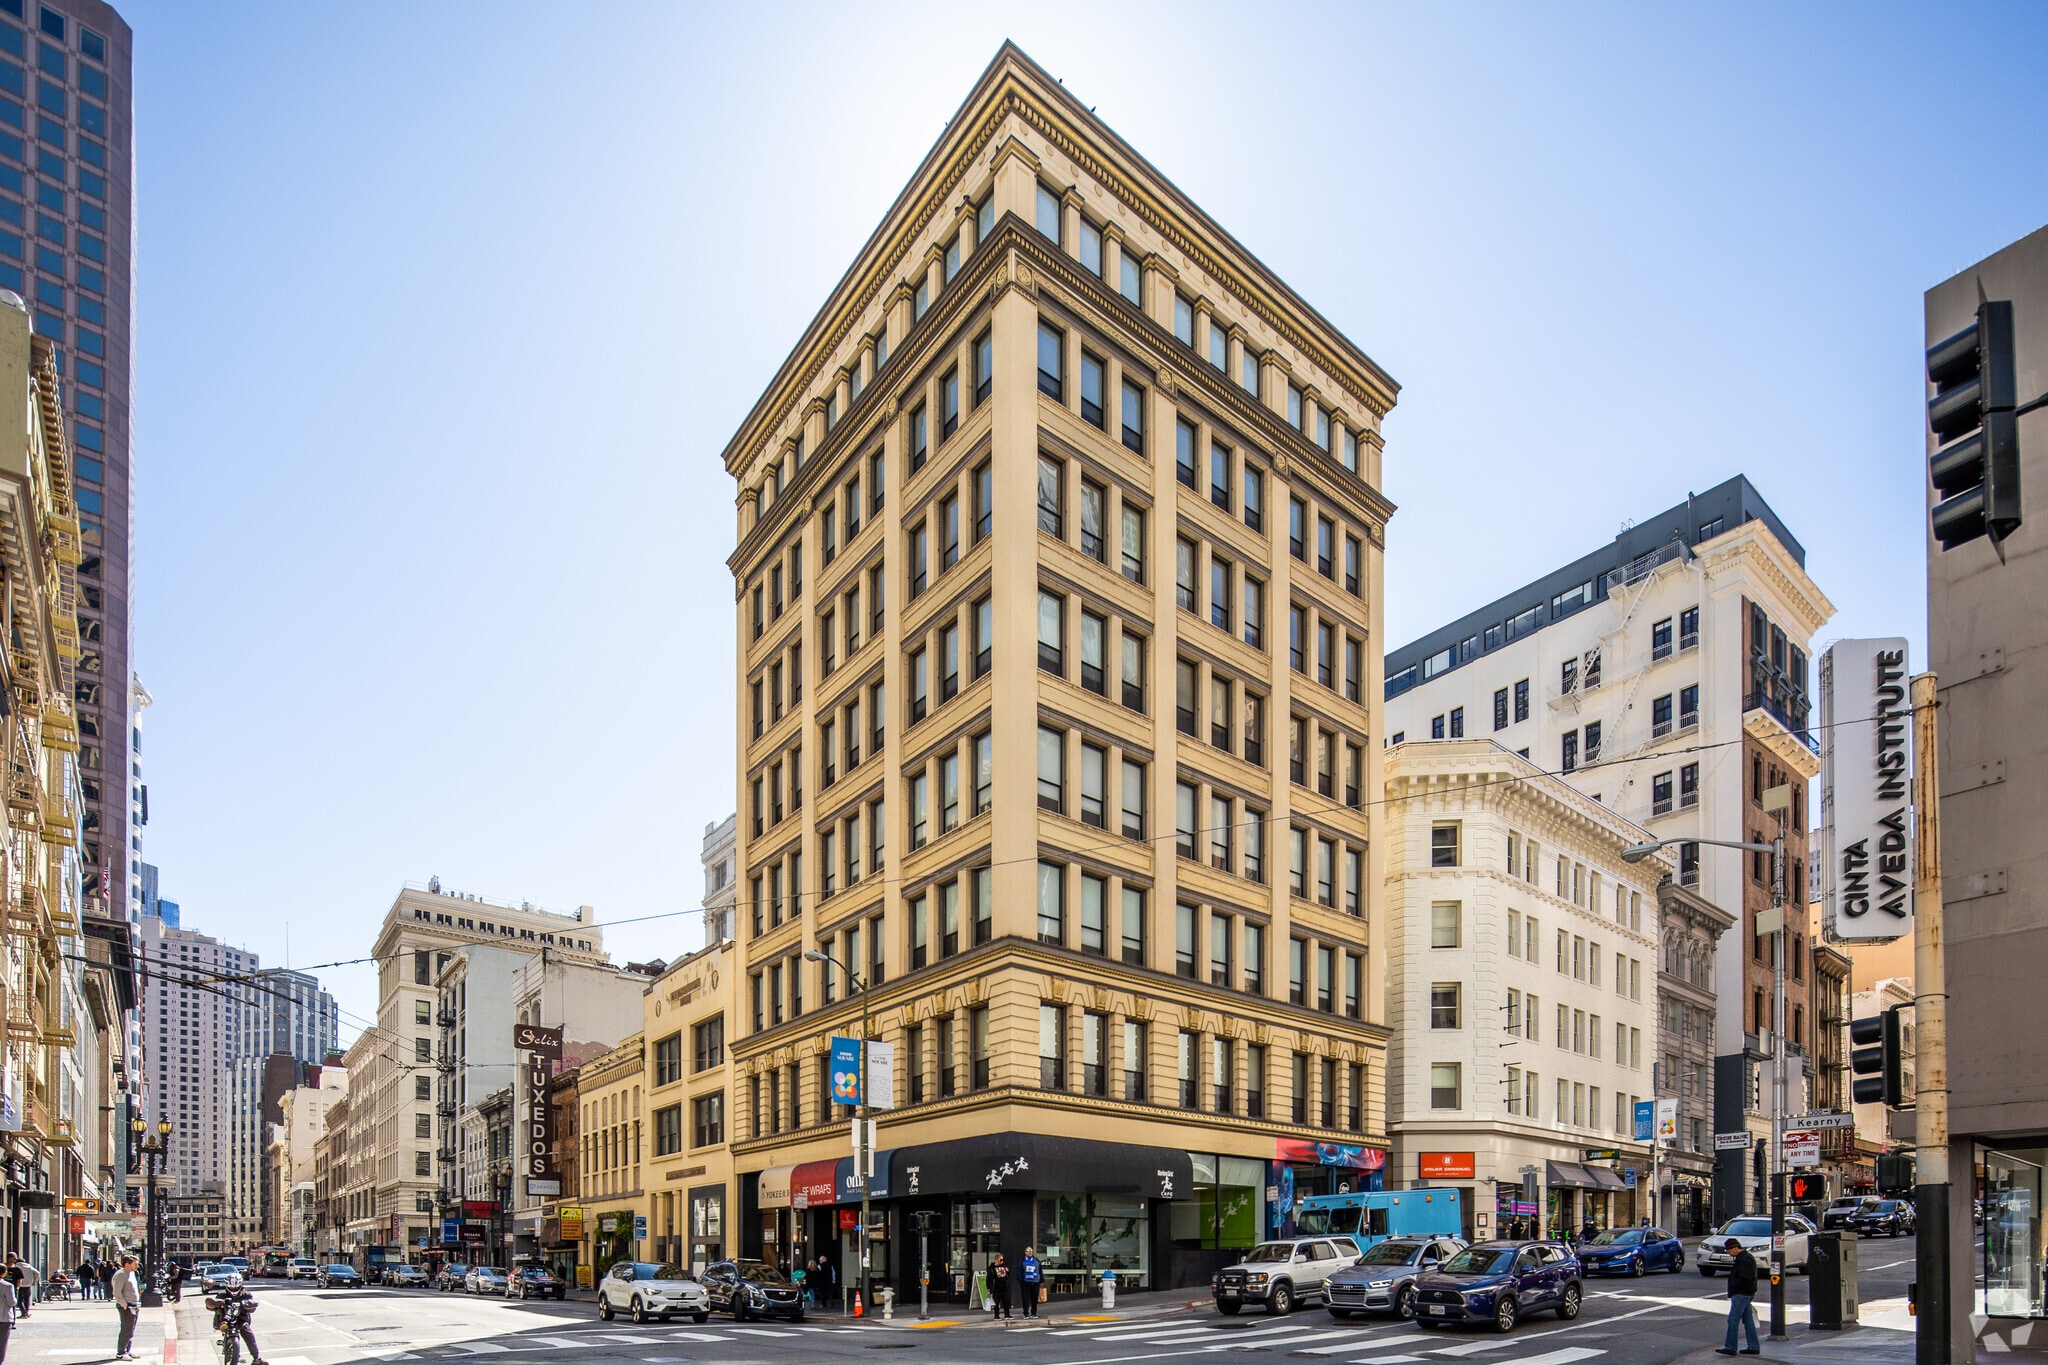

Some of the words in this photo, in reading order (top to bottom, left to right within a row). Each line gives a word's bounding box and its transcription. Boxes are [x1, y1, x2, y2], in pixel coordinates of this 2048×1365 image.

[1877, 650, 1906, 800] INSTITUTE
[1844, 837, 1870, 918] CINTA
[1878, 806, 1907, 919] AVEDA
[518, 1030, 558, 1046] Selix
[532, 1054, 546, 1173] TUXEDOS
[1798, 1118, 1841, 1127] Kearny
[766, 1191, 781, 1199] YOKEE
[810, 1184, 831, 1196] WRAPS
